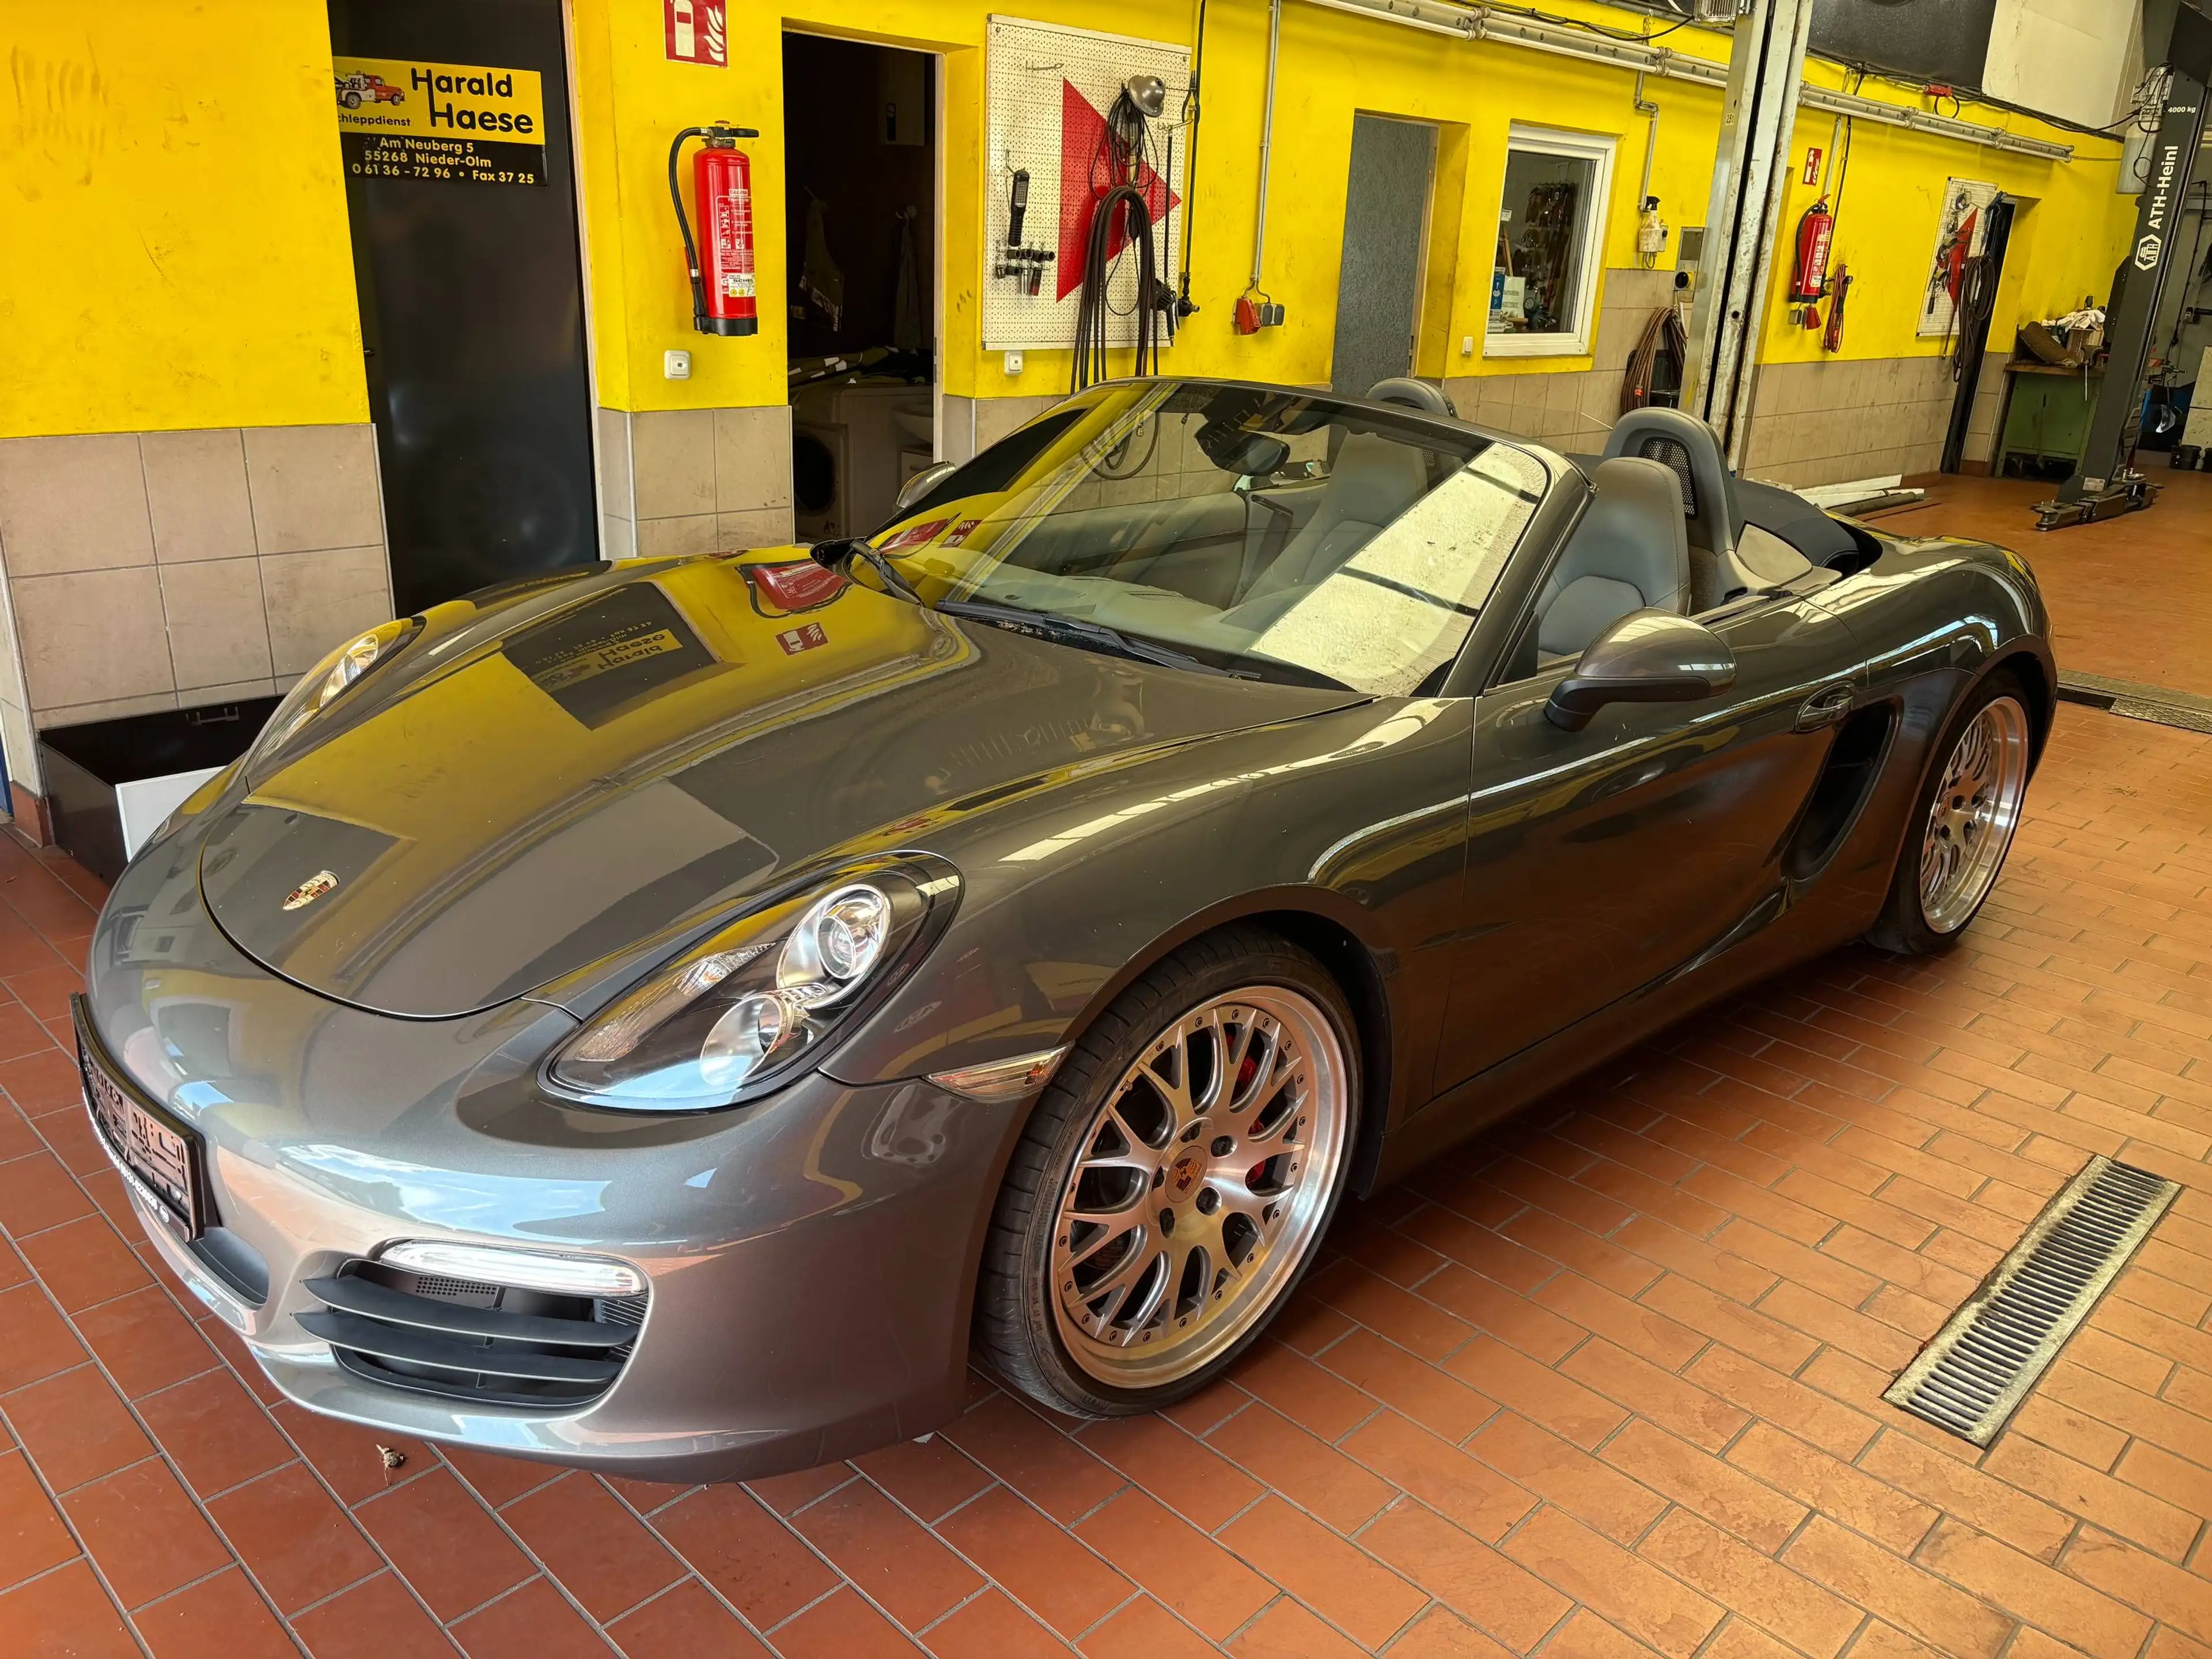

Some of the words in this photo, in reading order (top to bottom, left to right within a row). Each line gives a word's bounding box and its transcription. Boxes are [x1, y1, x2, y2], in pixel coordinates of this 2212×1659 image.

[411, 67, 513, 98] Harald
[430, 103, 533, 134] Haese
[380, 137, 402, 149] Am
[405, 139, 463, 154] Neuberg
[467, 142, 474, 153] 5
[365, 150, 408, 162] 55268
[415, 153, 491, 167] Nieder-Olm
[472, 169, 495, 181] Fax
[498, 172, 514, 183] 37
[518, 173, 535, 184] 25
[2148, 146, 2179, 229] ATH-Heinl
